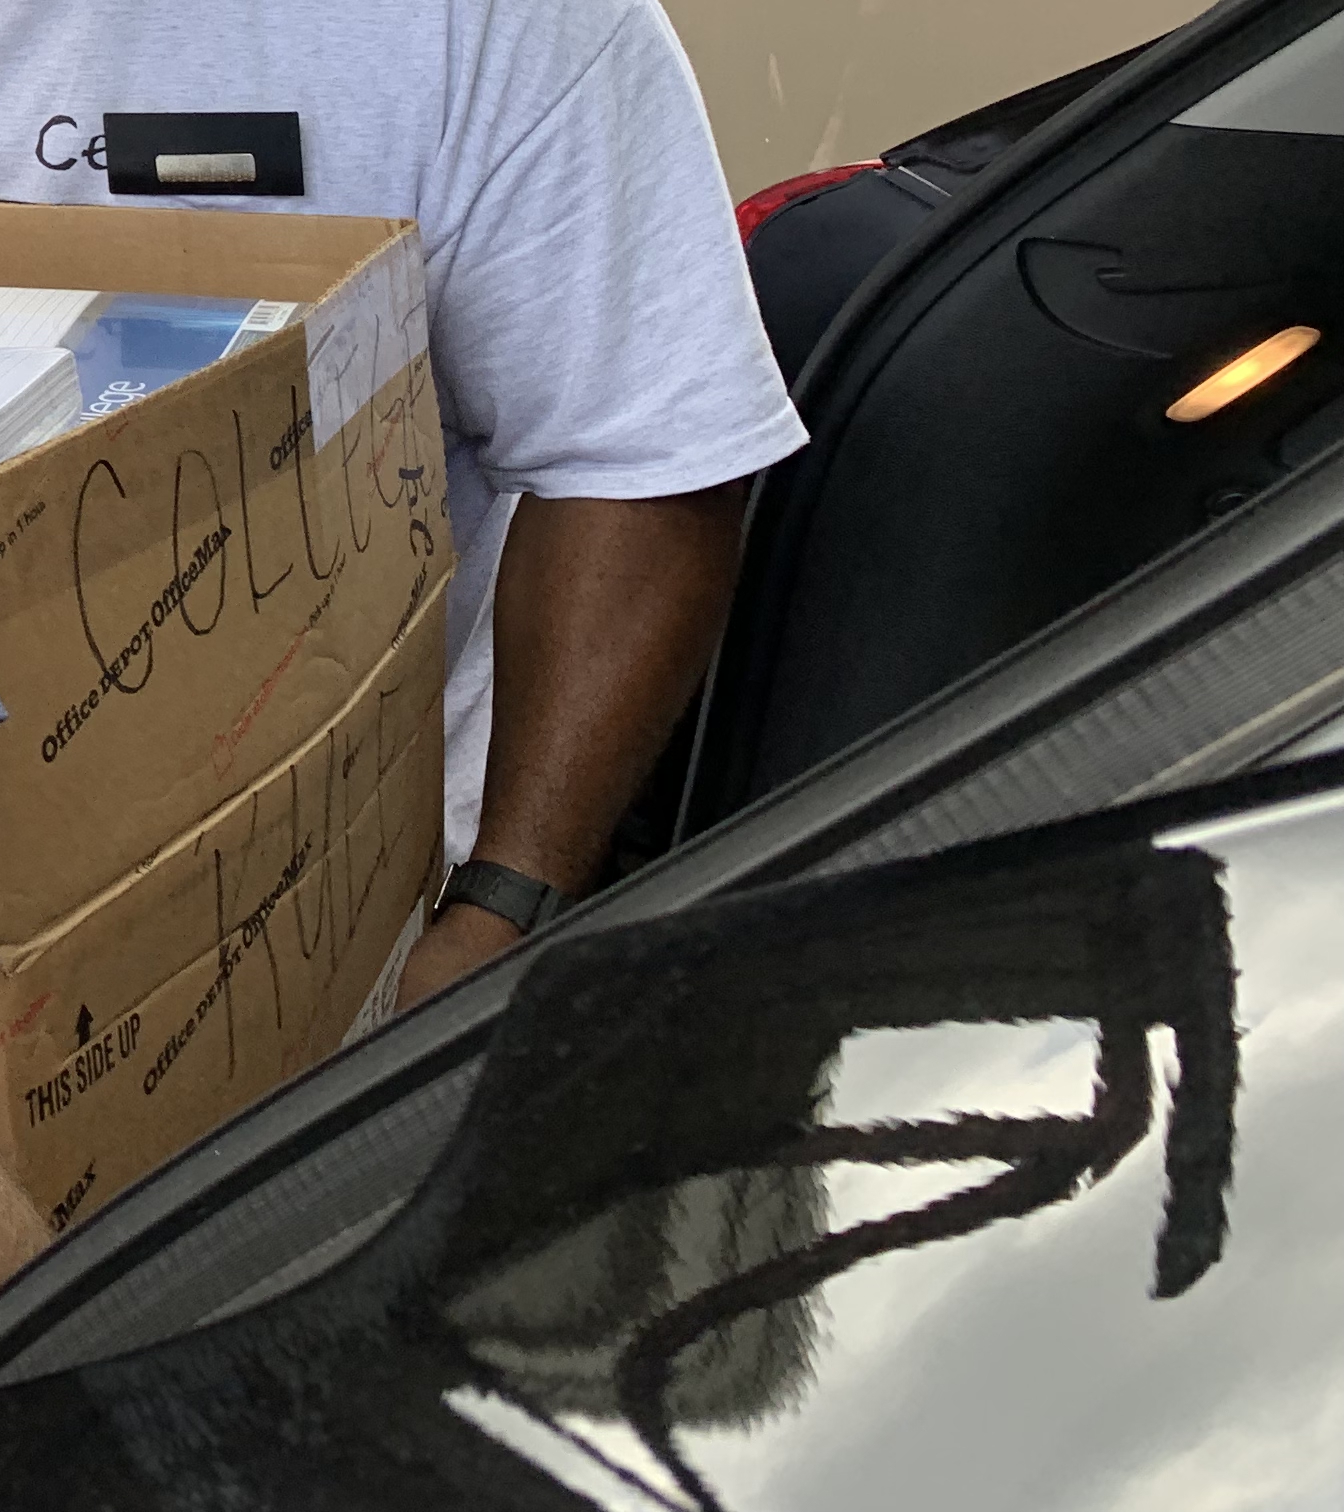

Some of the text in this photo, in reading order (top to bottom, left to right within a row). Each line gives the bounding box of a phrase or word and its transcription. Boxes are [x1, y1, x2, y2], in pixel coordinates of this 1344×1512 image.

[41, 688, 100, 764] Office
[98, 620, 154, 697] DEPOT
[25, 1012, 141, 1128] THIS SIDE UP
[142, 1017, 196, 1096] Office
